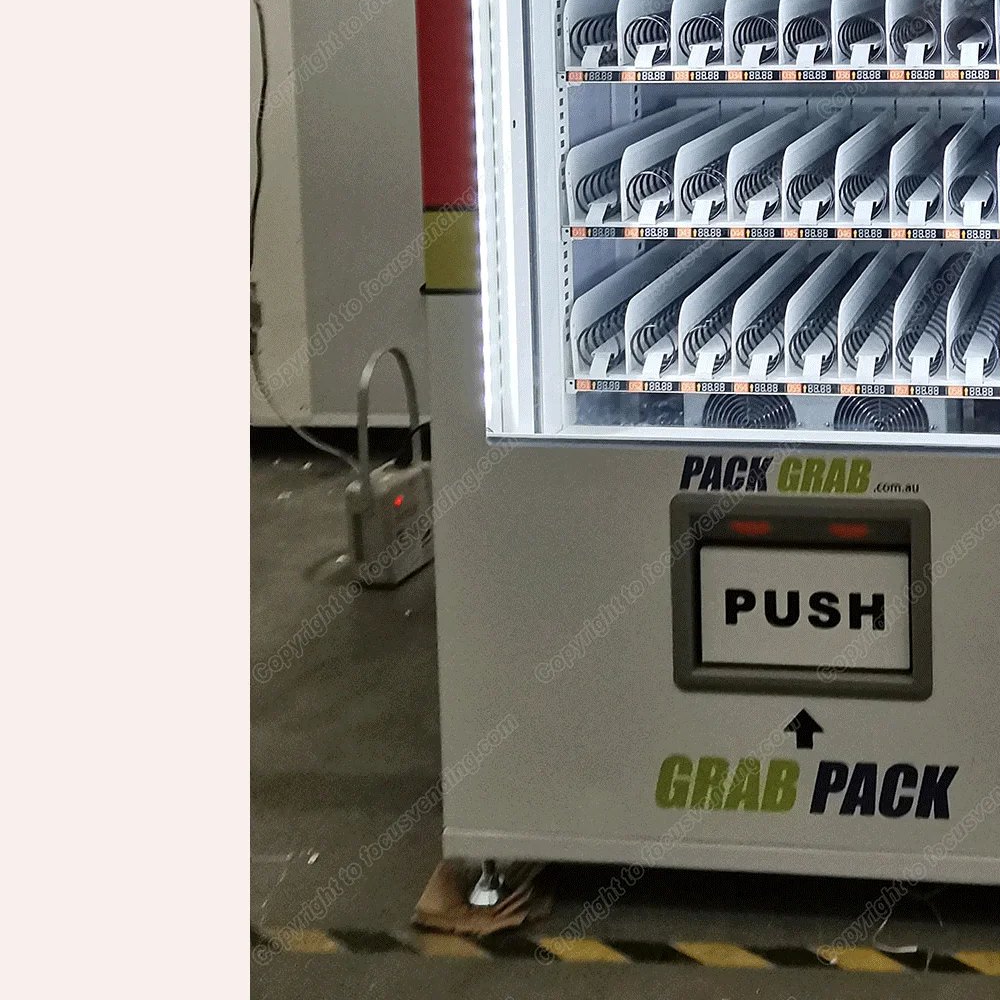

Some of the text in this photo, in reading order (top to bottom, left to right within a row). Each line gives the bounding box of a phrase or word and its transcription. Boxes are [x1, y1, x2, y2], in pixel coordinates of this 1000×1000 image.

[680, 455, 920, 494] PACK GRAB .com.au
[724, 588, 885, 631] PUSH
[655, 753, 959, 819] GRAB PACK
